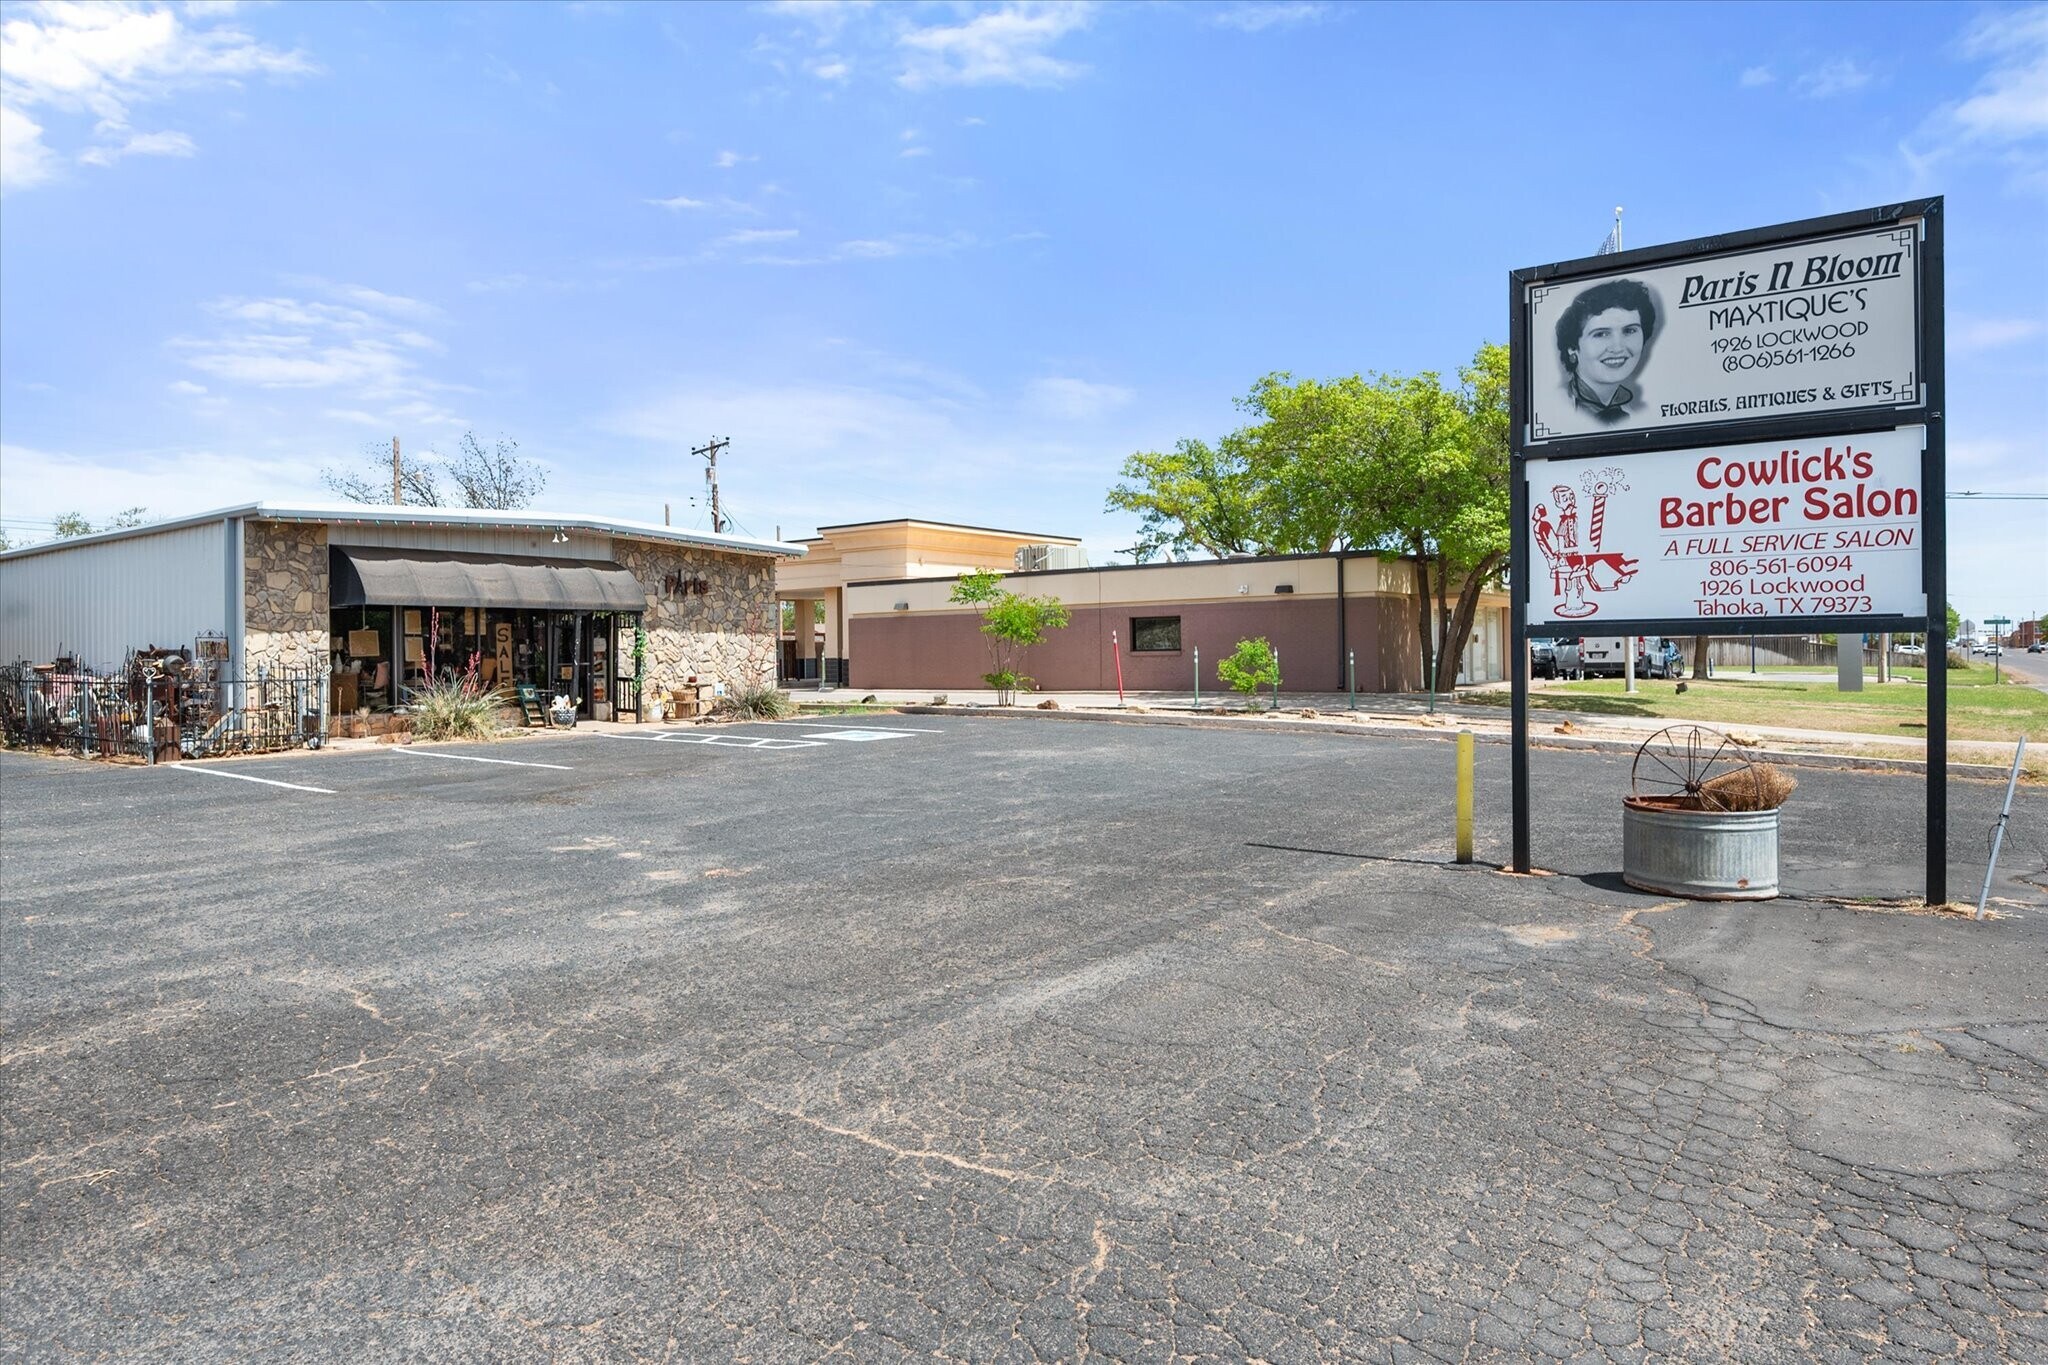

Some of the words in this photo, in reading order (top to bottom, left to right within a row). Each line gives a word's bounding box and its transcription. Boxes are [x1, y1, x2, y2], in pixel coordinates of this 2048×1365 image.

[1679, 270, 1760, 305] Paris
[1800, 251, 1904, 288] Bloom
[1709, 287, 1869, 331] MAXTIQUE'S
[1710, 335, 1753, 354] 1926
[1756, 320, 1870, 349] LOCKWOOD
[1722, 341, 1856, 374] (806)561-1266
[1660, 397, 1731, 418] FLORALS,
[1735, 388, 1818, 410] ANTIQUES
[1822, 386, 1837, 401] &
[1840, 379, 1894, 399] GIFTS
[1695, 445, 1875, 490] Cowlick's
[1659, 492, 1790, 529] Barber
[1802, 483, 1919, 521] Salon
[1664, 540, 1679, 557] A
[1685, 537, 1735, 556] FULL
[1741, 532, 1829, 553] SERVICE
[1833, 527, 1915, 549] SALON
[1709, 555, 1854, 577] 806-561-6094
[1699, 579, 1743, 597] 1926
[1750, 573, 1866, 595] Lockwood
[1693, 597, 1769, 618] Tahoka,
[1774, 597, 1804, 615] TX
[1810, 595, 1873, 614] 79373
